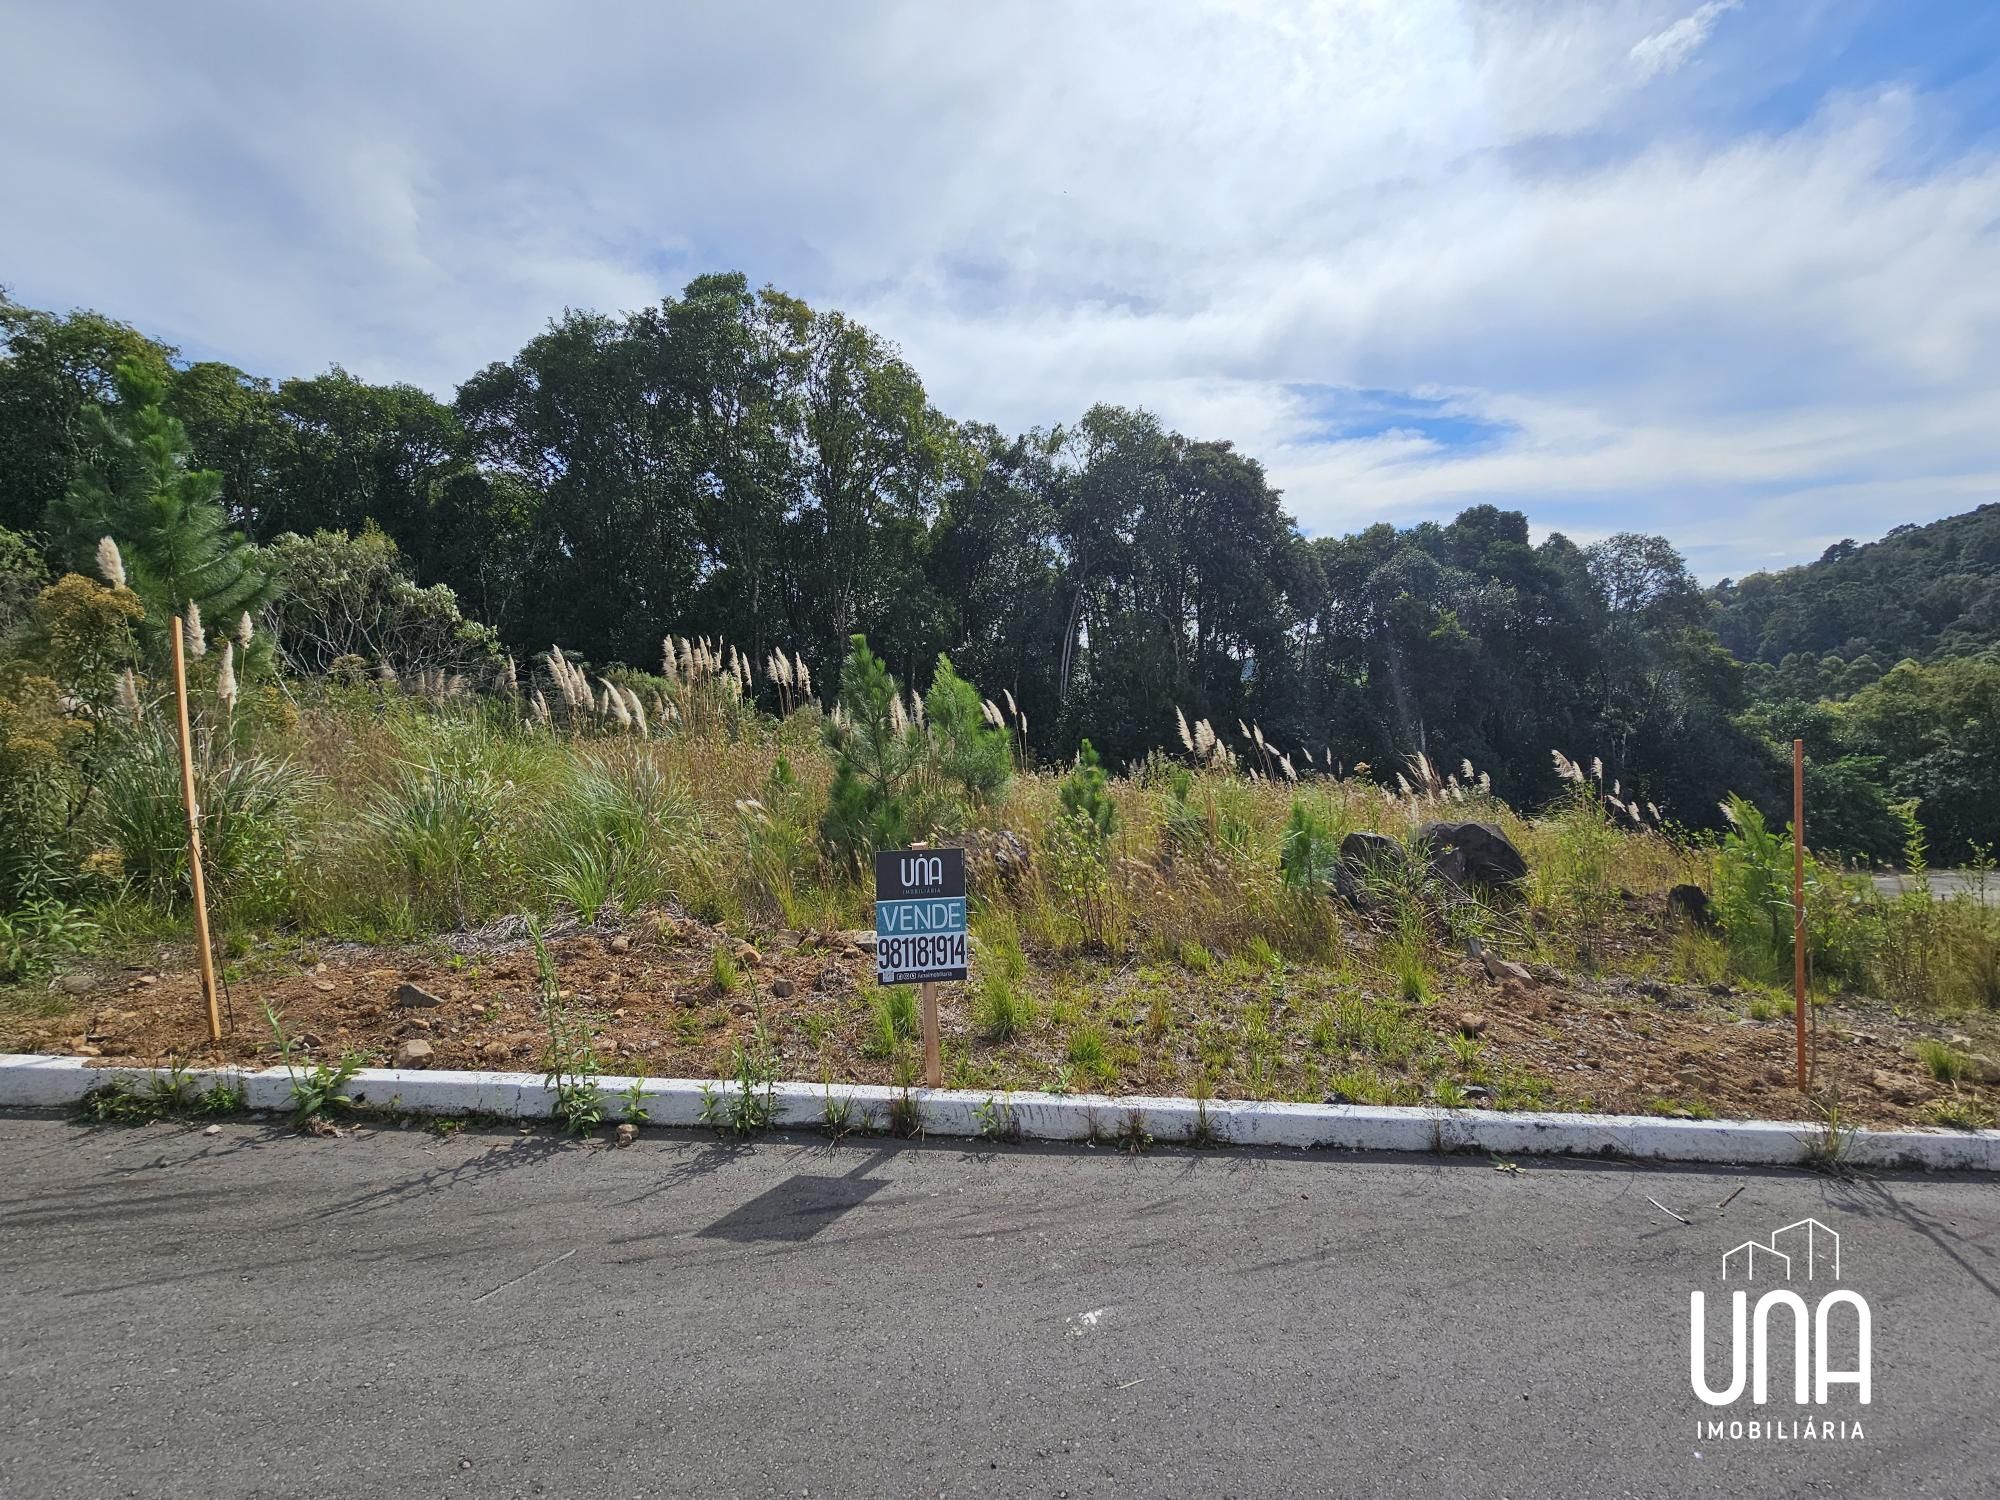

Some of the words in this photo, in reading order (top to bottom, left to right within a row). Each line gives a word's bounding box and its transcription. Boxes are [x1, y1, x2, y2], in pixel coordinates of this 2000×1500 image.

[901, 857, 943, 886] UNA
[882, 903, 961, 932] VENDE
[878, 934, 965, 970] 981181914
